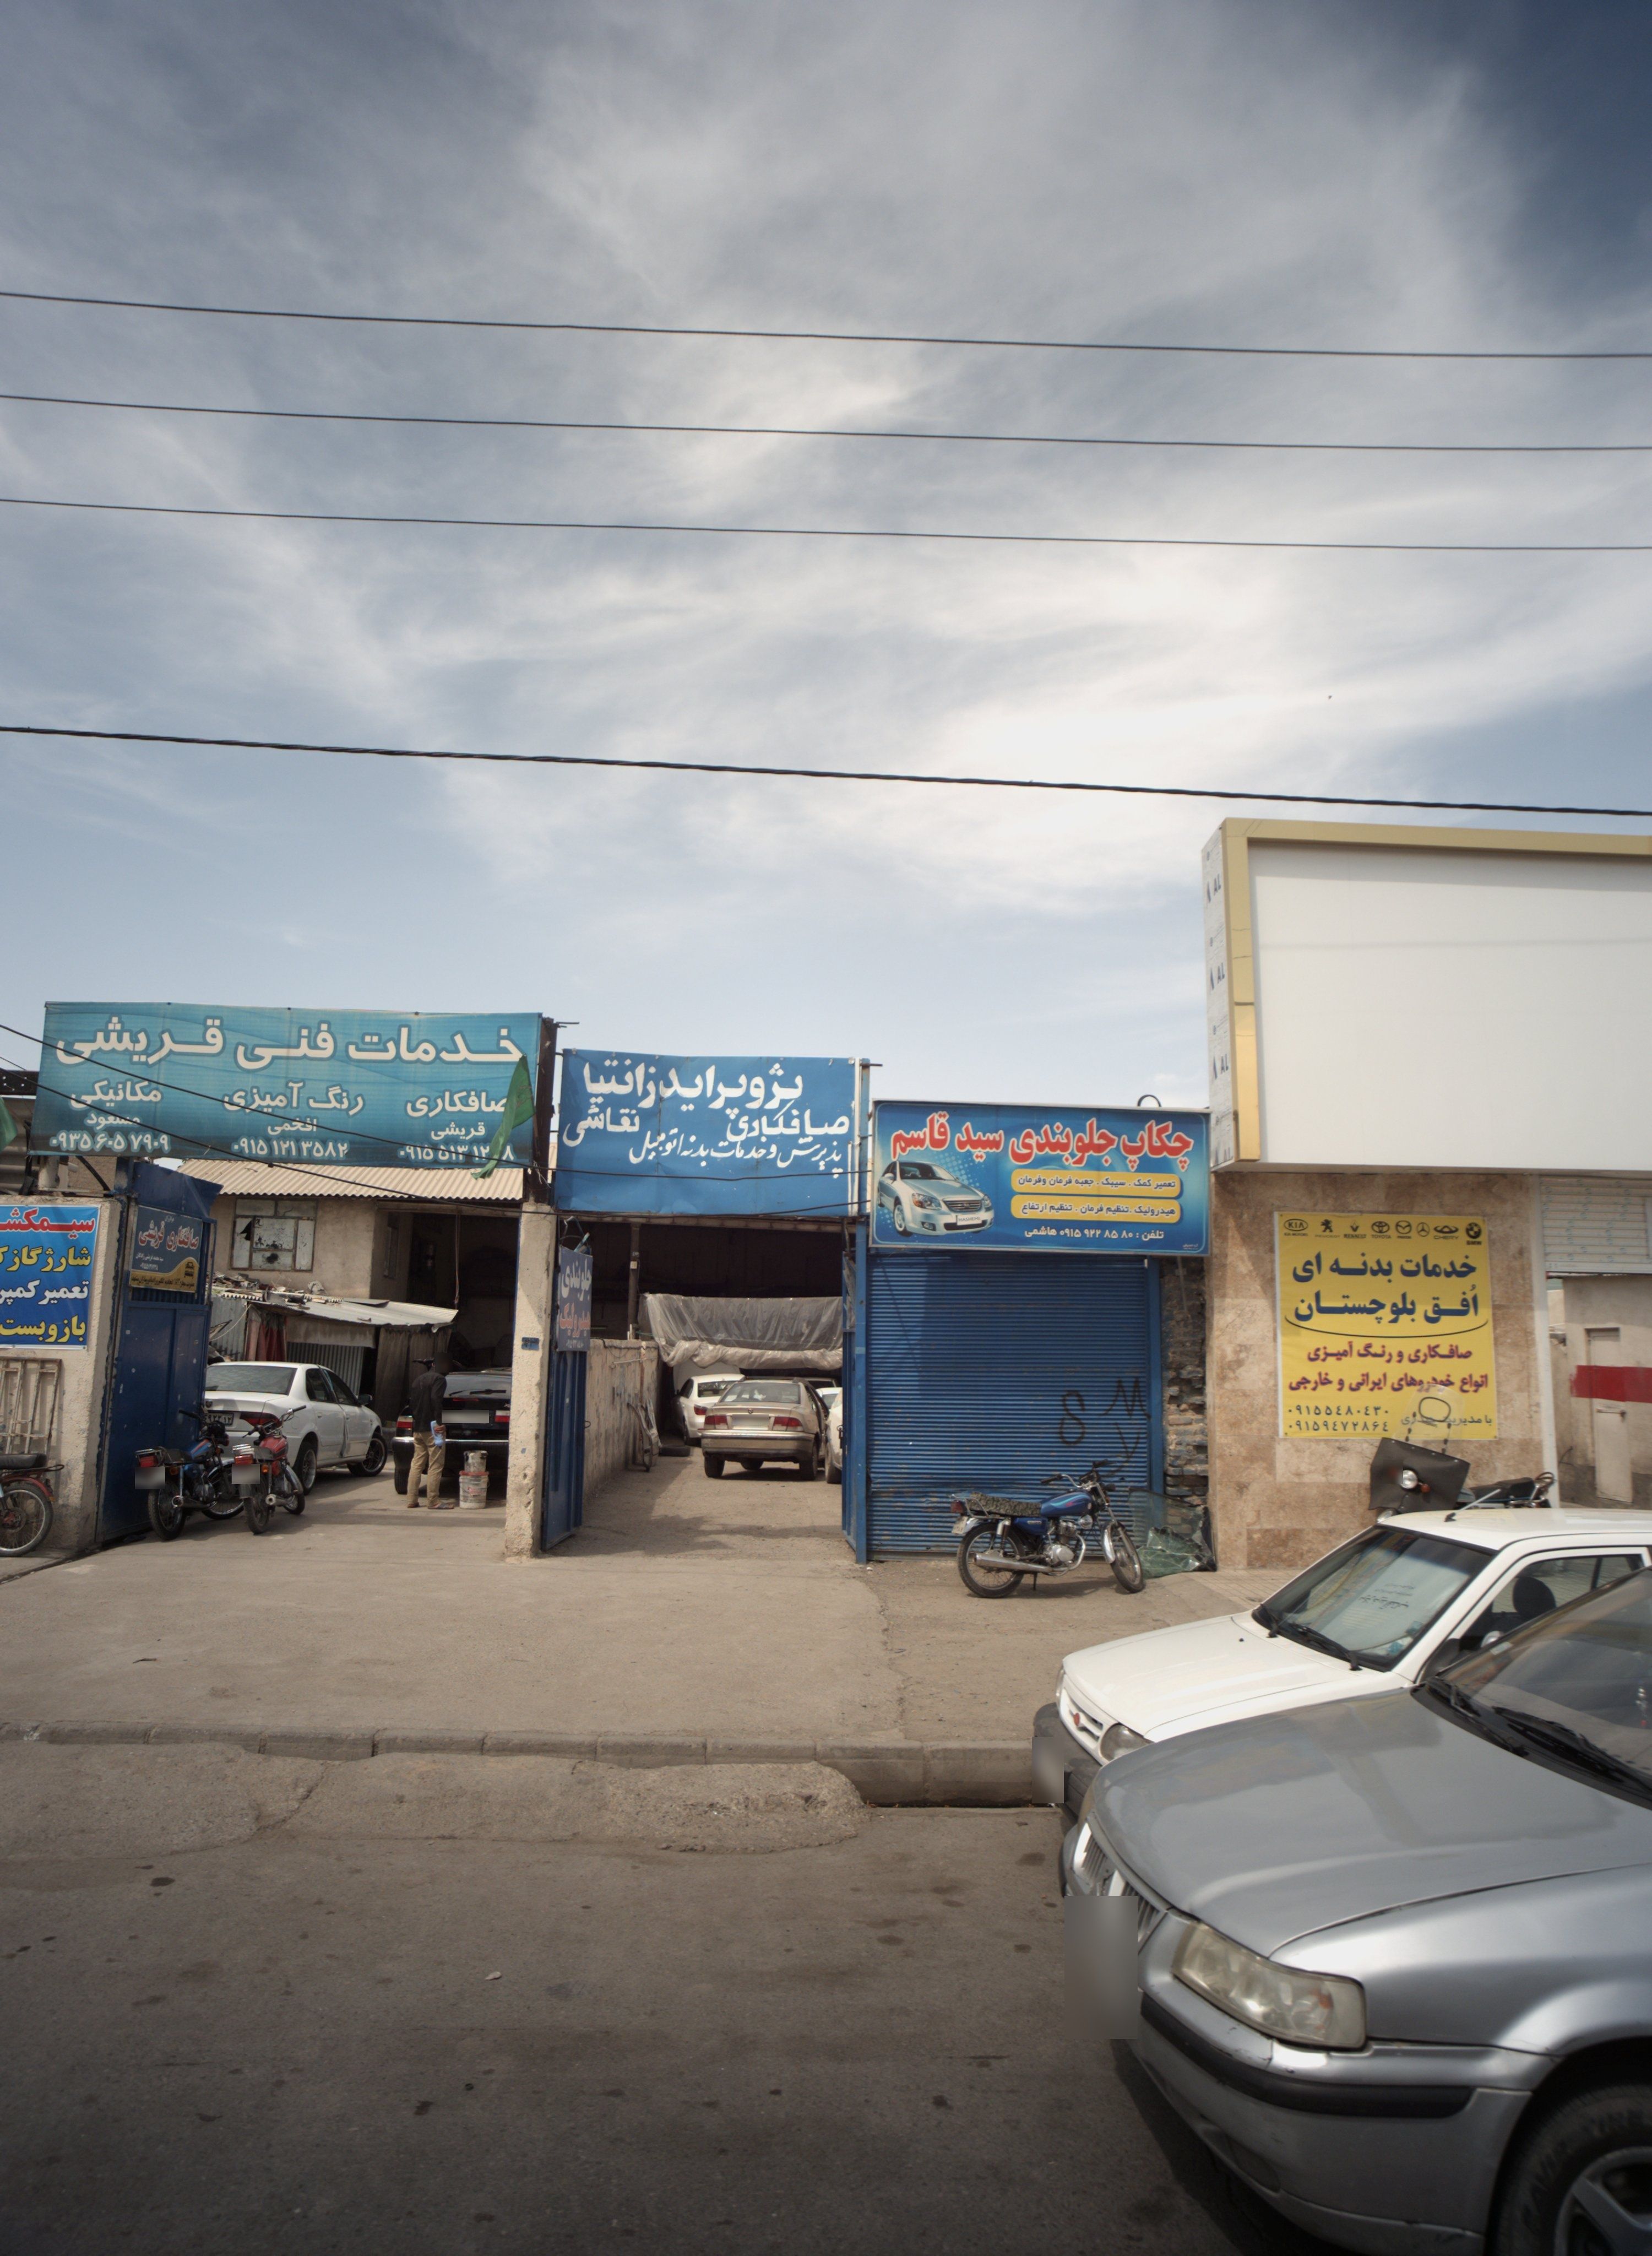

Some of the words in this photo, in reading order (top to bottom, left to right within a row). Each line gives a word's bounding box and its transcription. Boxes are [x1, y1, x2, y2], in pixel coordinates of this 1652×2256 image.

[56, 1016, 223, 1065] قریشی
[236, 1023, 334, 1070] فنی
[348, 1027, 523, 1062] خدمات
[70, 1080, 162, 1108] مکانیکی
[583, 1059, 656, 1109] زانتیا
[224, 1081, 304, 1113] آمیزی
[308, 1086, 364, 1116] رنگ
[86, 1113, 140, 1130] مسعود
[267, 1118, 317, 1135] افخمی
[431, 1122, 486, 1140] قریشی
[562, 1104, 640, 1147] نقاشی
[726, 1099, 850, 1142] صافکاری
[629, 1127, 684, 1164] اتومبیل
[891, 1111, 951, 1161] قاسم
[955, 1121, 1004, 1162] سید
[1009, 1118, 1118, 1167] جلوبندی
[1120, 1120, 1194, 1172] چکاپ
[680, 1135, 709, 1167] بدنه
[777, 1136, 844, 1179] پذیرش
[1048, 1175, 1073, 1186] فرمان
[1074, 1178, 1094, 1187] جعبه
[1101, 1177, 1126, 1188] سیبک
[1133, 1179, 1152, 1187] کمک
[1153, 1180, 1176, 1190] تعمیر
[1021, 1202, 1047, 1214] ارتفاع
[1049, 1202, 1073, 1213] تنظیم
[1080, 1203, 1104, 1214] فرمان
[1134, 1205, 1176, 1217] هیدرولیک
[0, 1207, 96, 1239] سیمکش
[1024, 1226, 1057, 1237] هاشمی
[1142, 1229, 1164, 1241] تلفن
[6, 1245, 44, 1272] گاز
[40, 1246, 91, 1272] شارژ
[1292, 1251, 1322, 1283] ای
[1329, 1252, 1393, 1283] بدنه
[1400, 1253, 1477, 1278] خدمات
[37, 1281, 90, 1305] تعمیر
[1307, 1341, 1353, 1363] آمیزی
[1357, 1343, 1393, 1364] رنگ
[1396, 1349, 1404, 1363] و
[1408, 1344, 1473, 1364] صافکاری
[1289, 1371, 1333, 1391] خارجی
[1337, 1378, 1344, 1391] و
[1349, 1372, 1387, 1392] ایرانی
[1459, 1373, 1488, 1393] انواع
[1485, 1414, 1492, 1426] با
